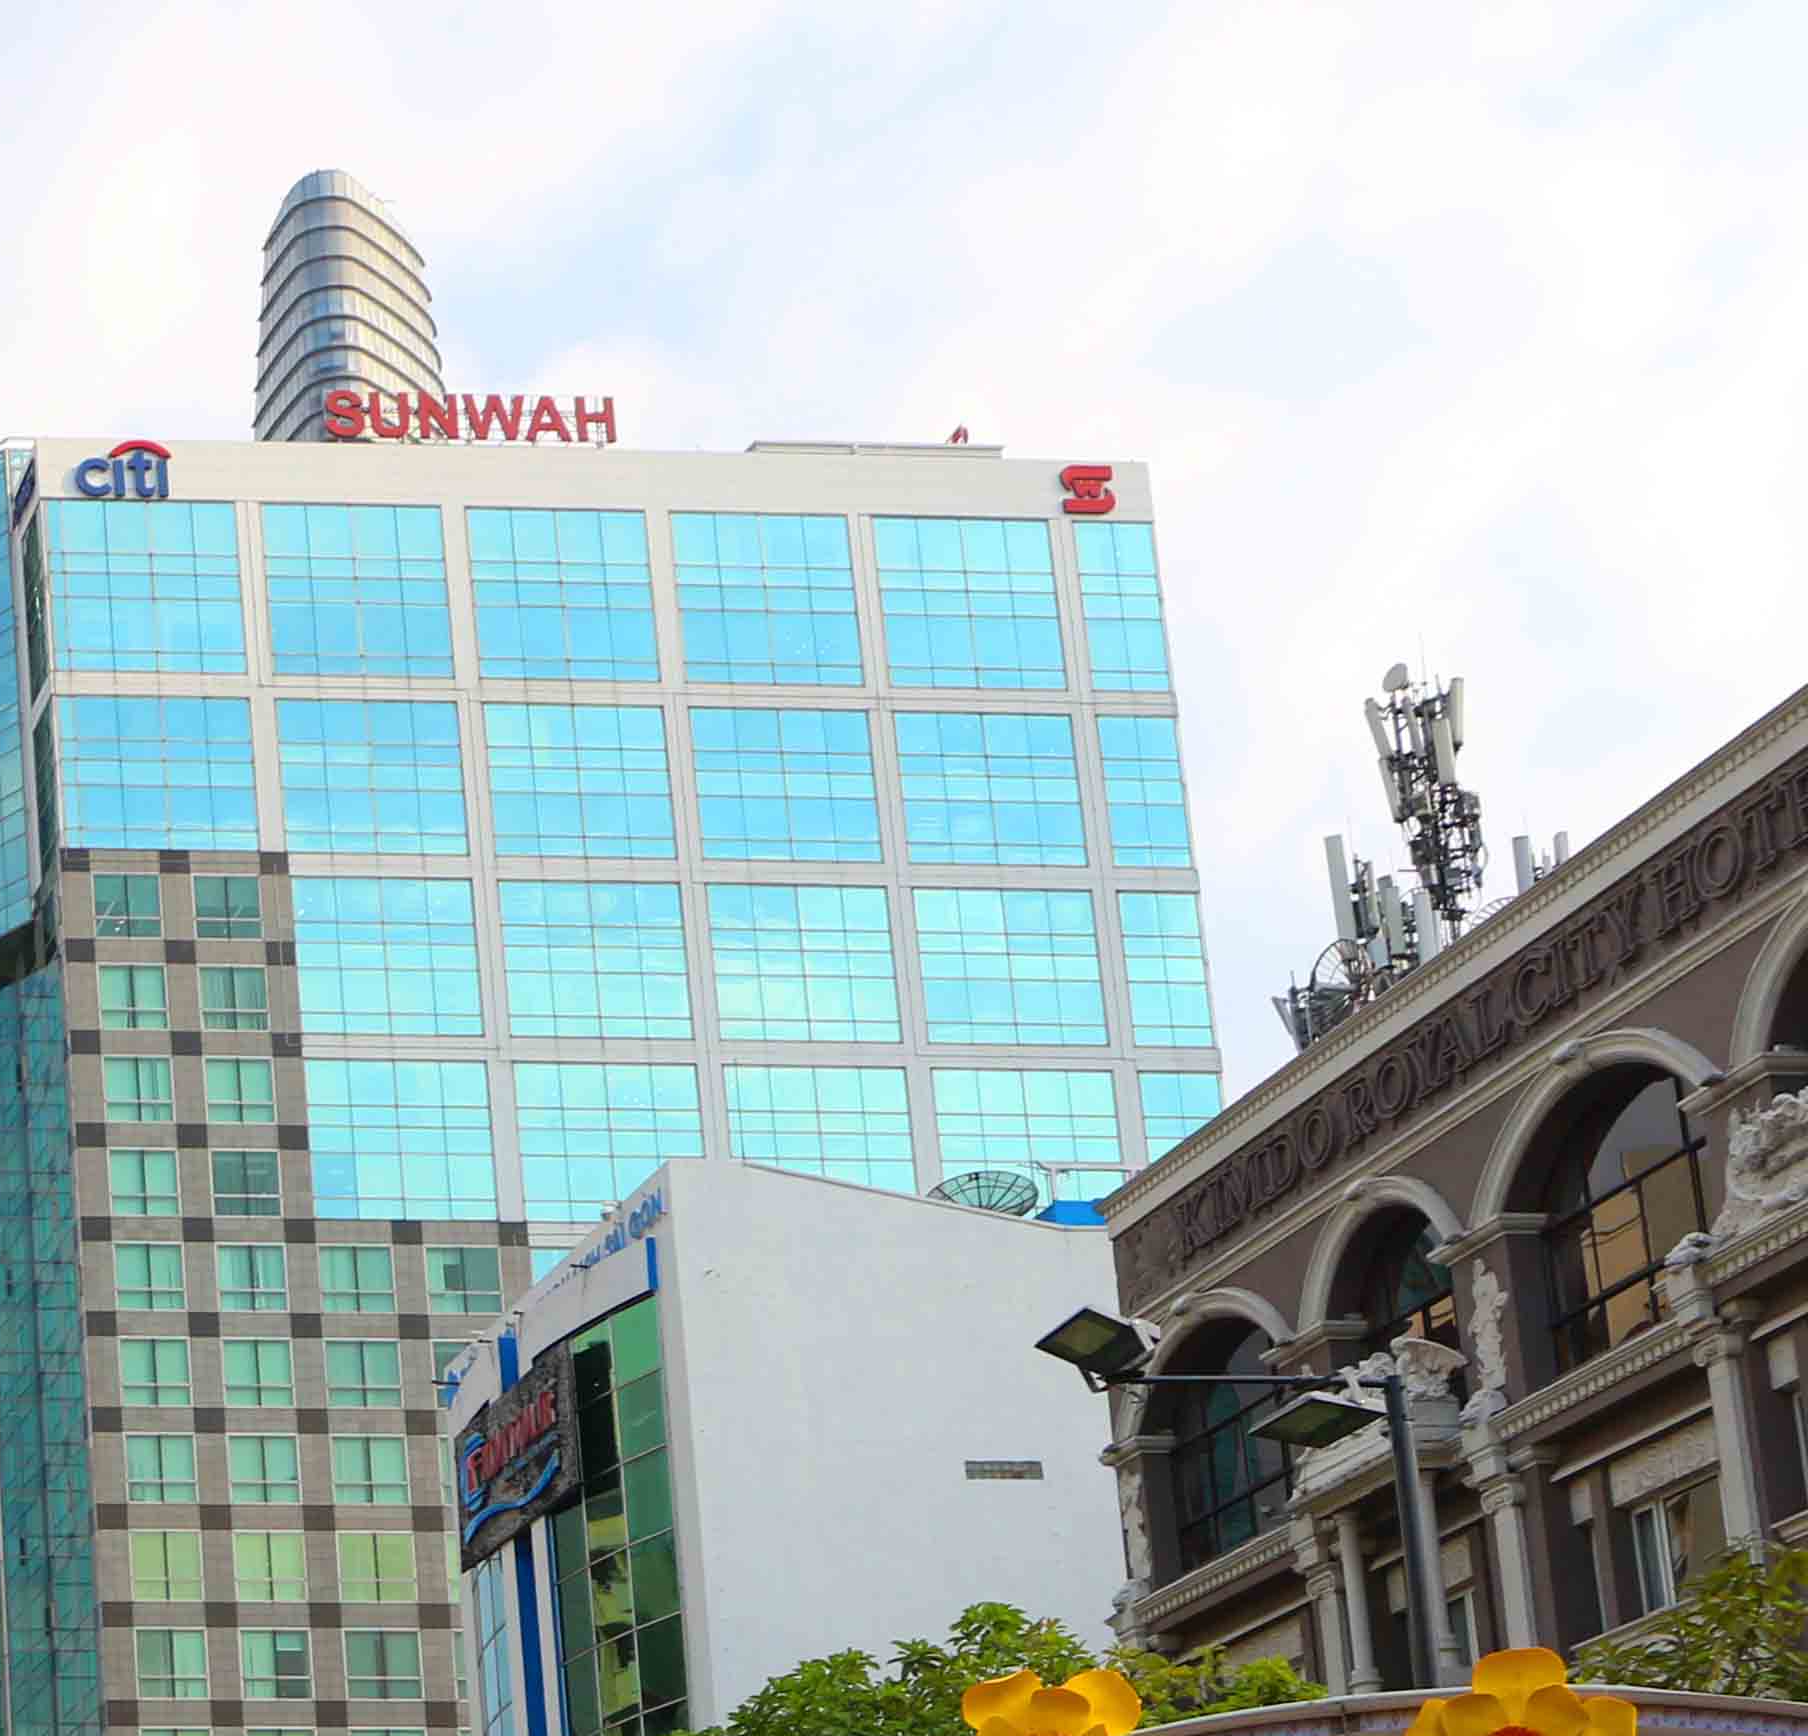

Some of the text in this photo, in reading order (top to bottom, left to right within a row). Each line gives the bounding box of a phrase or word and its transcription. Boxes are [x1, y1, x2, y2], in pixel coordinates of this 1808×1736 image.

[323, 389, 617, 444] SUNWAH
[74, 446, 171, 498] citi
[1340, 985, 1508, 1136] ROYAL
[1513, 874, 1648, 1026] CITY
